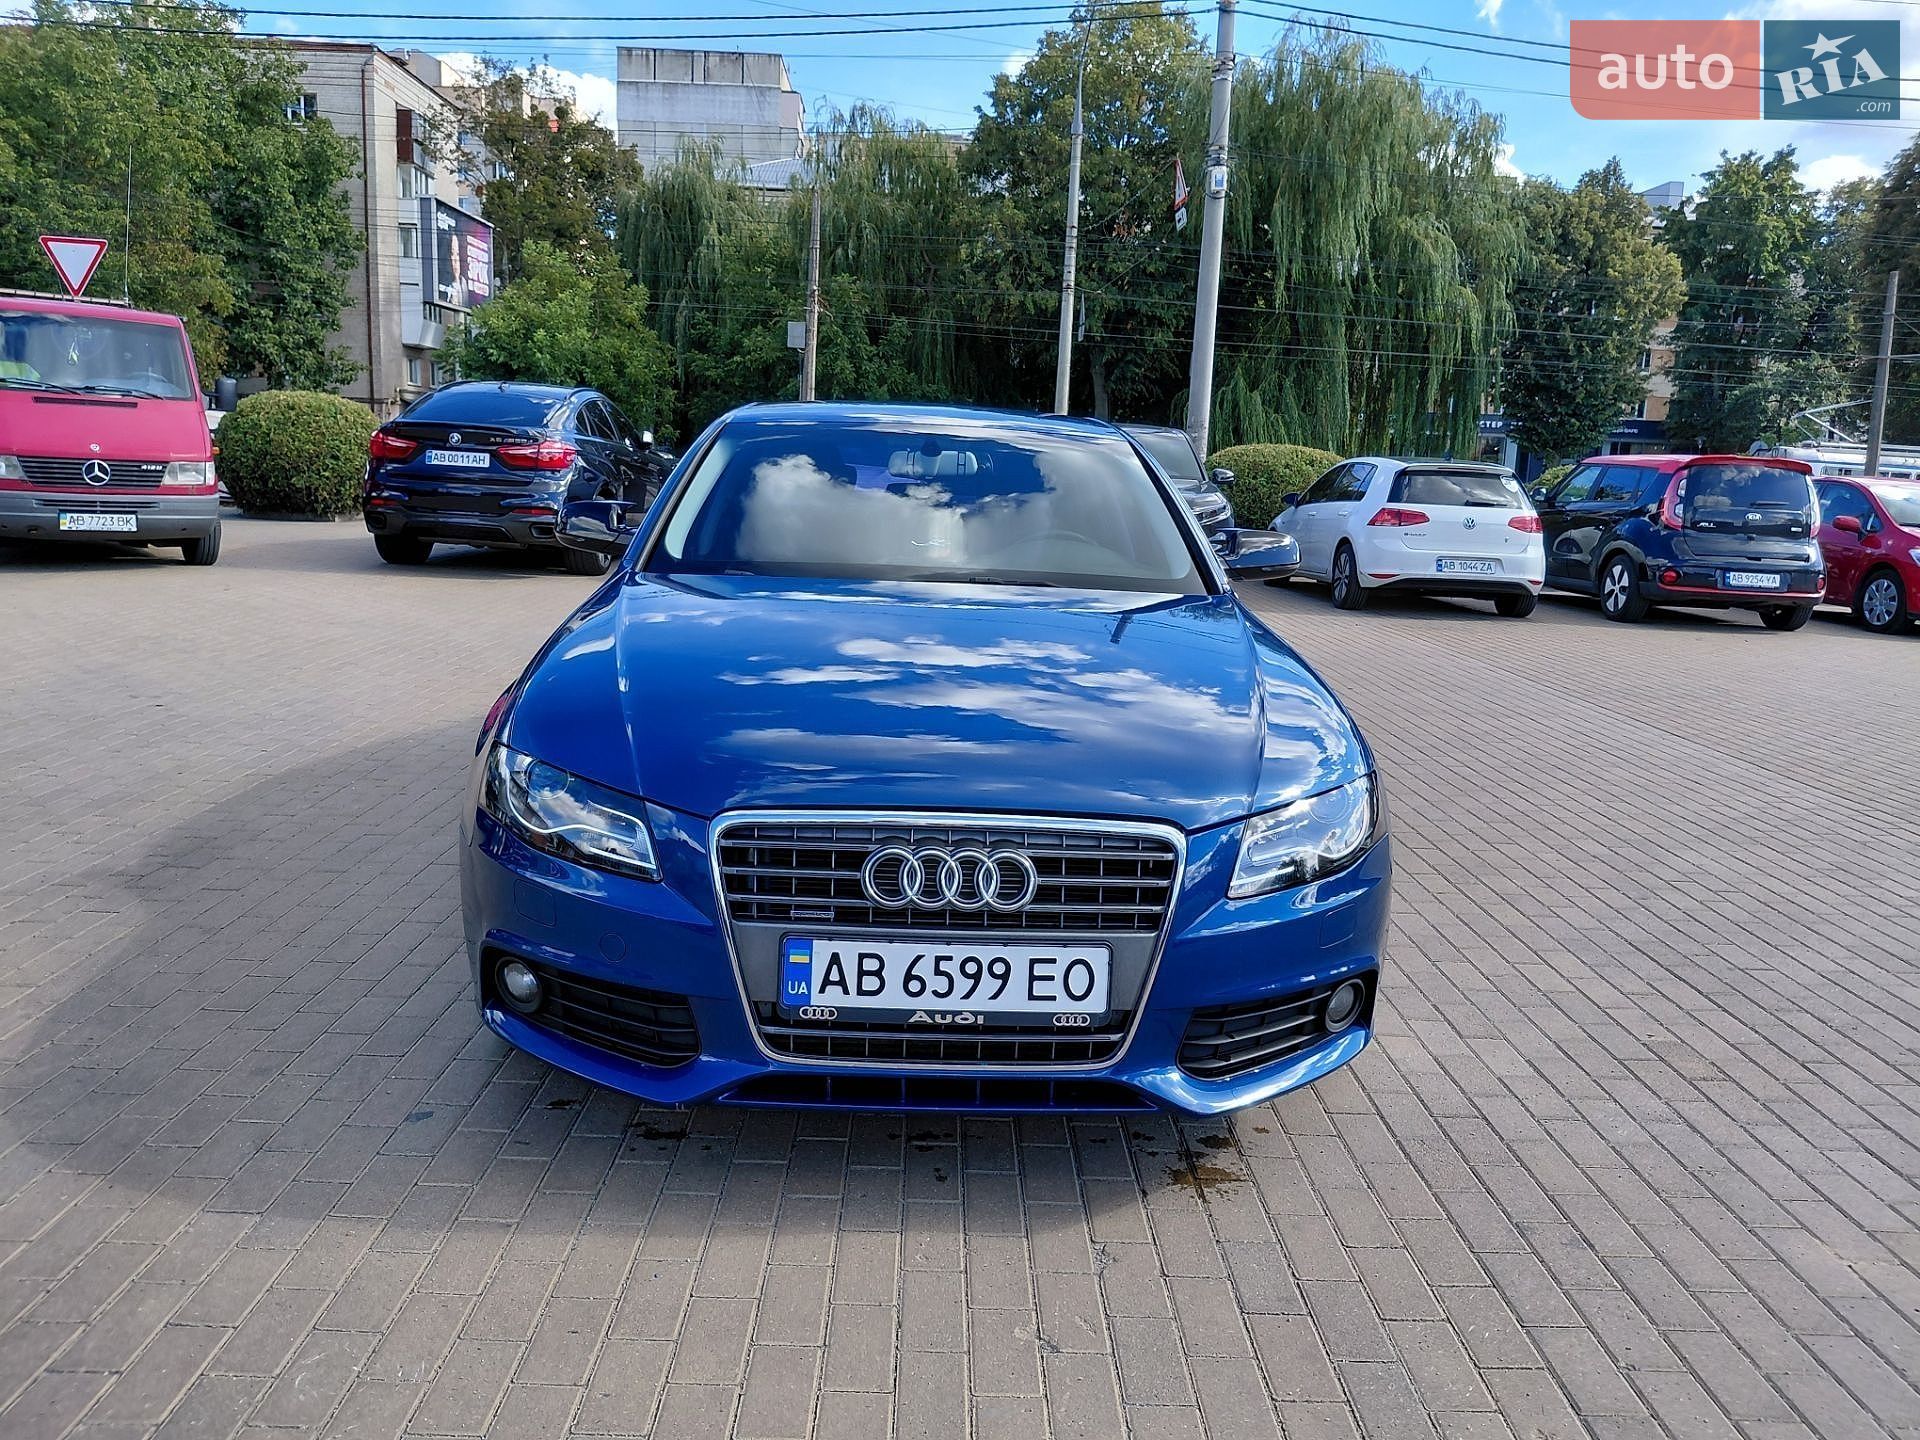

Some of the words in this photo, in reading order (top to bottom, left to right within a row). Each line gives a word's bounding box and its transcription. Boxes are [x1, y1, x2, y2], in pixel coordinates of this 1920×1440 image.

[1476, 420, 1503, 428] СТЕР
[432, 452, 446, 462] AB
[448, 453, 469, 464] 0011
[472, 454, 486, 465] AH
[68, 516, 85, 526] AB
[88, 516, 115, 527] 7723
[117, 517, 134, 527] BK
[1443, 561, 1456, 571] AB
[1459, 561, 1478, 571] 1044
[1480, 562, 1493, 572] ZA
[1732, 574, 1743, 584] AB
[1744, 574, 1764, 584] 9254
[818, 951, 886, 997] AB
[902, 954, 1012, 1001] 6599
[1027, 957, 1095, 1002] EO
[788, 981, 808, 995] UA
[907, 1010, 985, 1025] Audi
